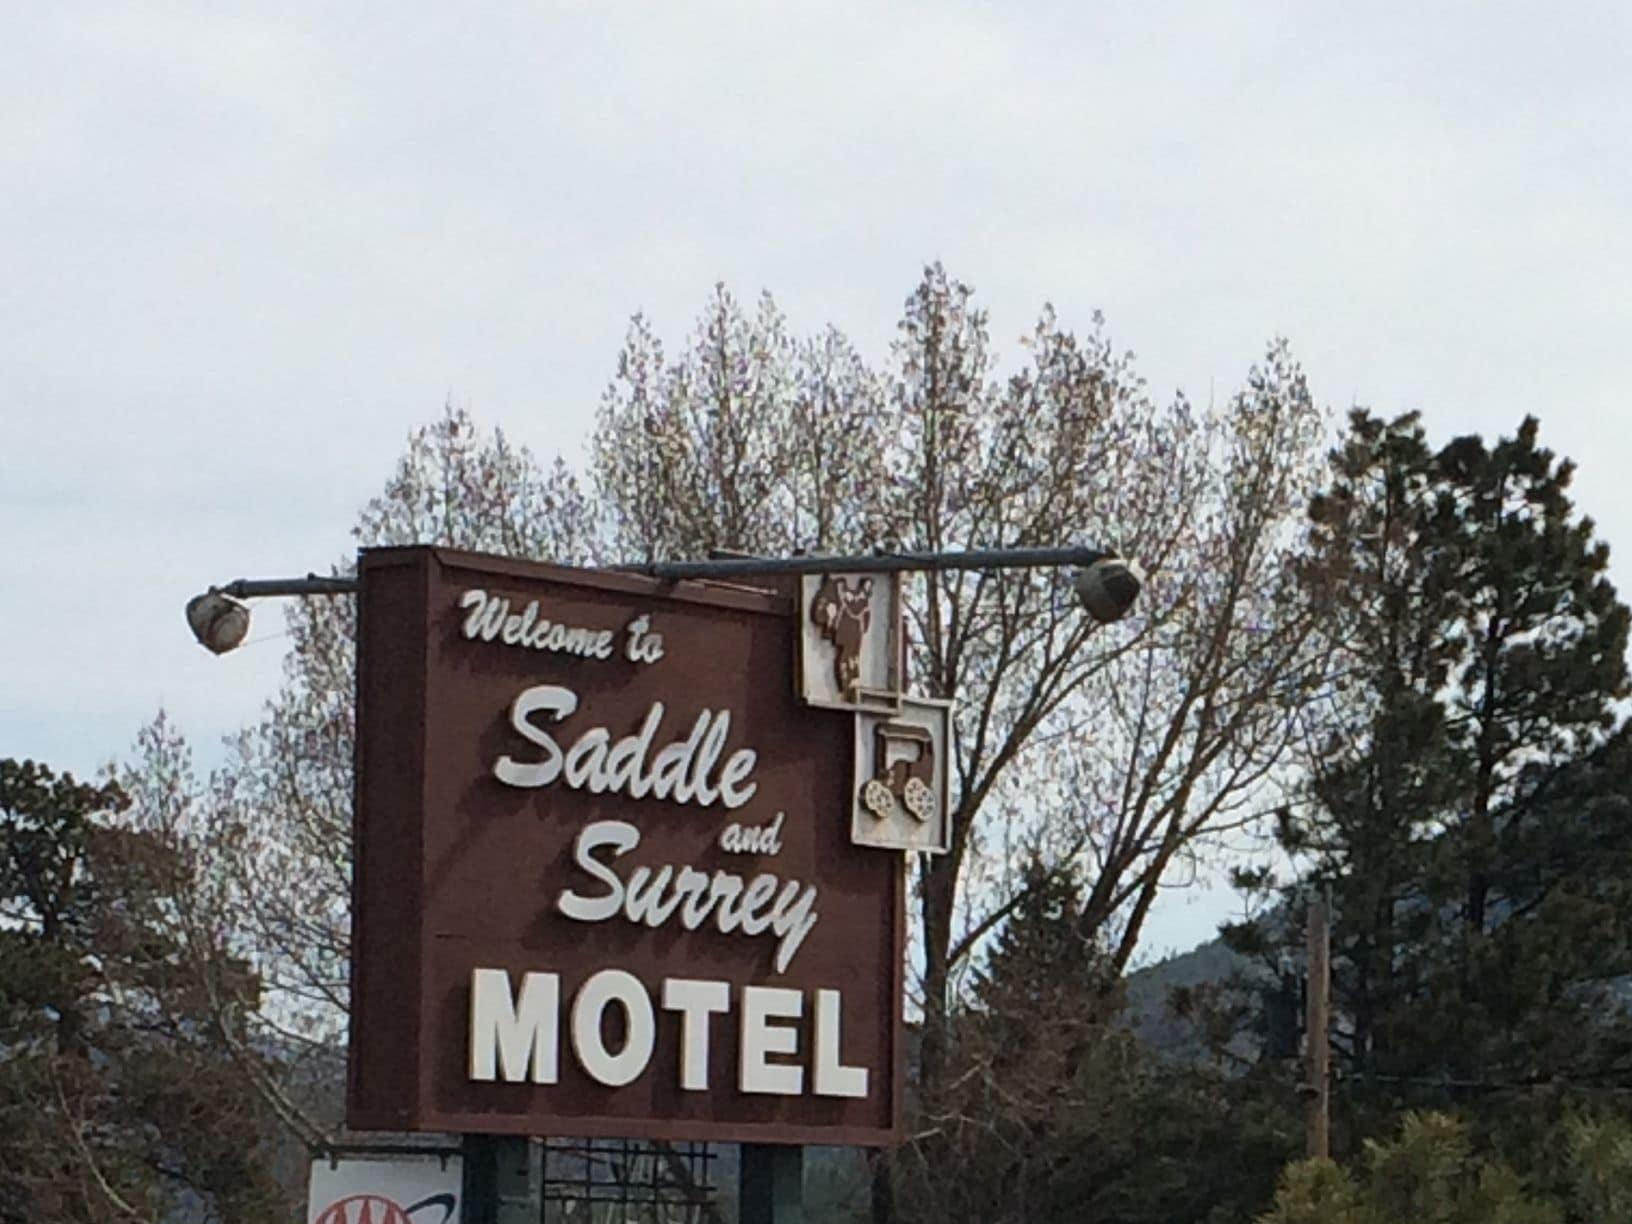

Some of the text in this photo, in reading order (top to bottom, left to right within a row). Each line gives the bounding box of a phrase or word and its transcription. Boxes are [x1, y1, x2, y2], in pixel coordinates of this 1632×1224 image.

[459, 589, 665, 664] Welcome to
[494, 685, 757, 809] Saddle
[720, 812, 784, 856] and
[557, 820, 818, 974] Surrey
[469, 967, 869, 1098] MOTEL
